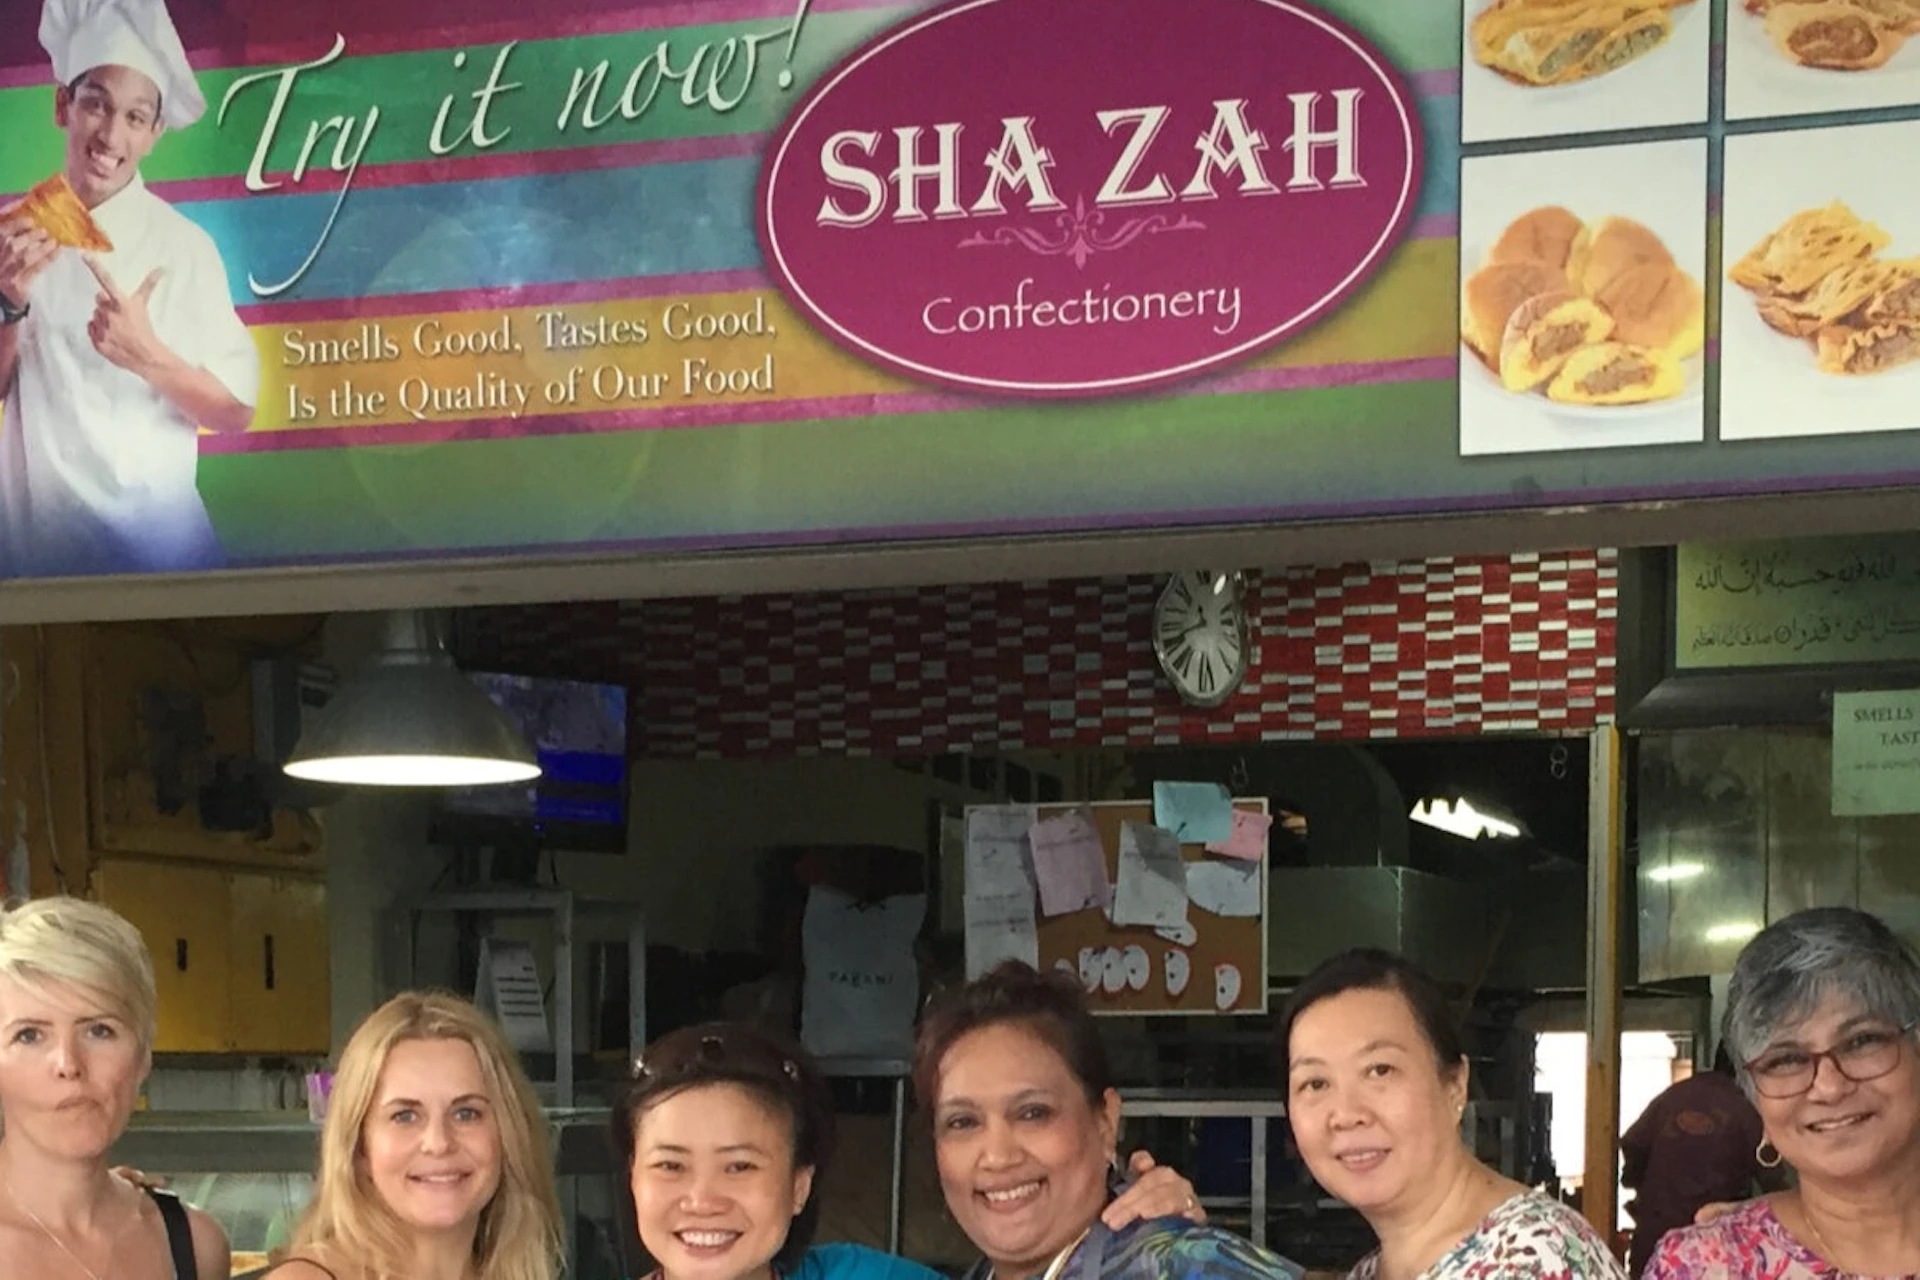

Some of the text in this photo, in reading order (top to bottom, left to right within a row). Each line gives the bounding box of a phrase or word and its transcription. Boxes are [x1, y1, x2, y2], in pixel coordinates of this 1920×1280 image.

[217, 0, 808, 296] Try it now!
[282, 296, 777, 367] Smells Good, Tastes Good,
[922, 278, 1242, 335] Confectionery
[288, 353, 775, 421] Is the Quality of Our Food
[1853, 707, 1913, 723] SMELLS
